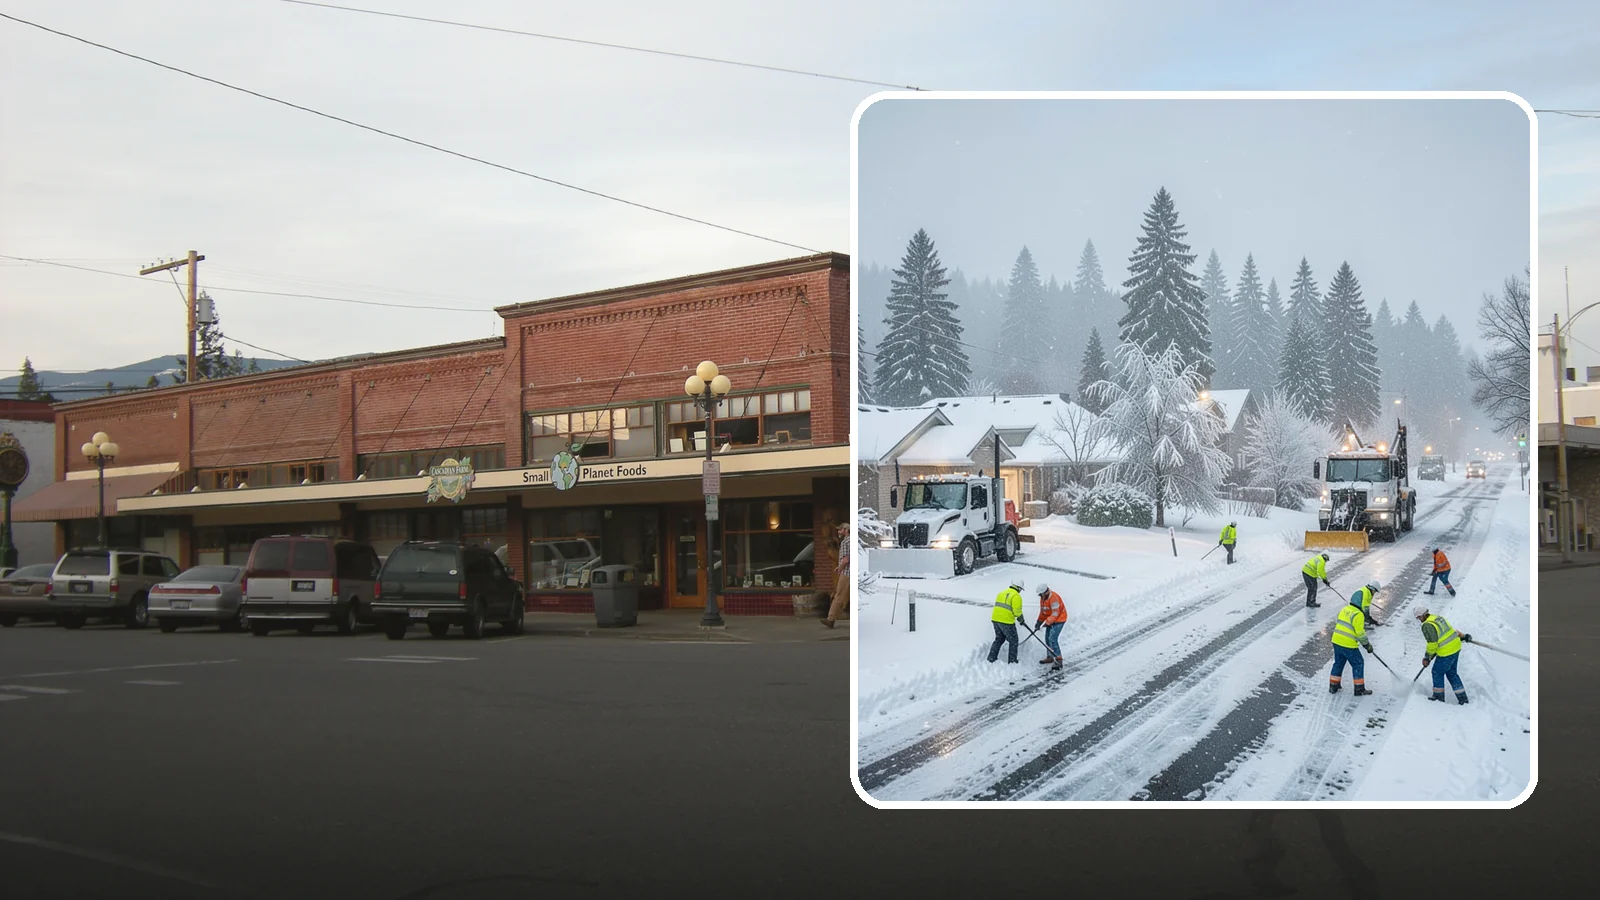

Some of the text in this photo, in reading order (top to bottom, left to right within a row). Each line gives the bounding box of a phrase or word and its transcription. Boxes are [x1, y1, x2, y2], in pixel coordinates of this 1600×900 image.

[523, 464, 647, 483] Small Planet Foods
